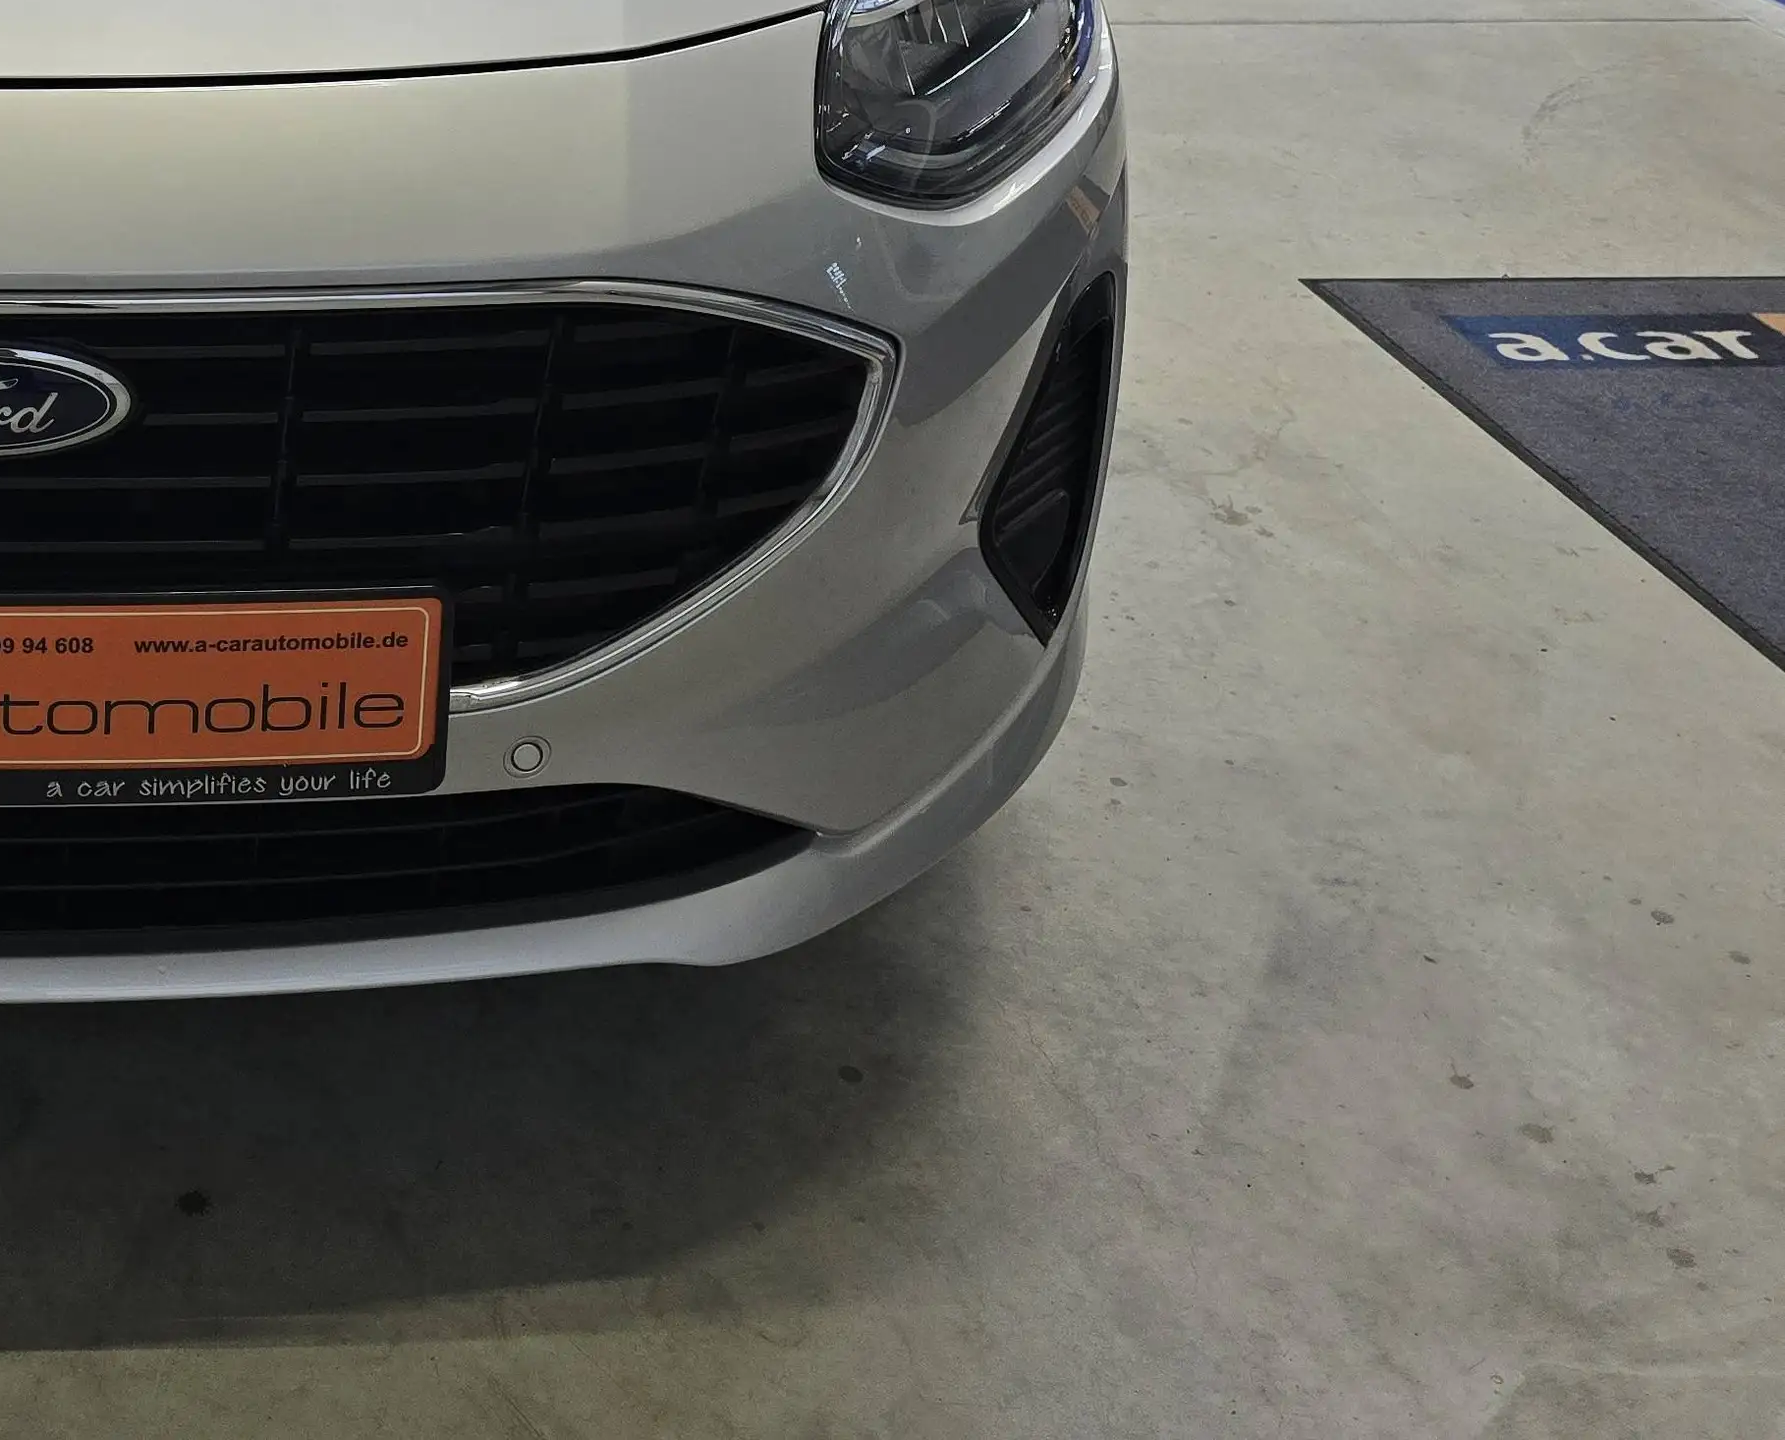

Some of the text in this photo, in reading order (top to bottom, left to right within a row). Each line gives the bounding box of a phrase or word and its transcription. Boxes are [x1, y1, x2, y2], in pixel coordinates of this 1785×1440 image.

[1487, 329, 1760, 363] a.car
[21, 636, 48, 655] 94
[54, 636, 95, 655] 608
[133, 632, 409, 655] www.a-carautomobile.de
[45, 779, 64, 799] a
[76, 779, 126, 799] car
[139, 773, 268, 802] simplifies
[280, 771, 337, 796] your
[349, 767, 392, 791] life
